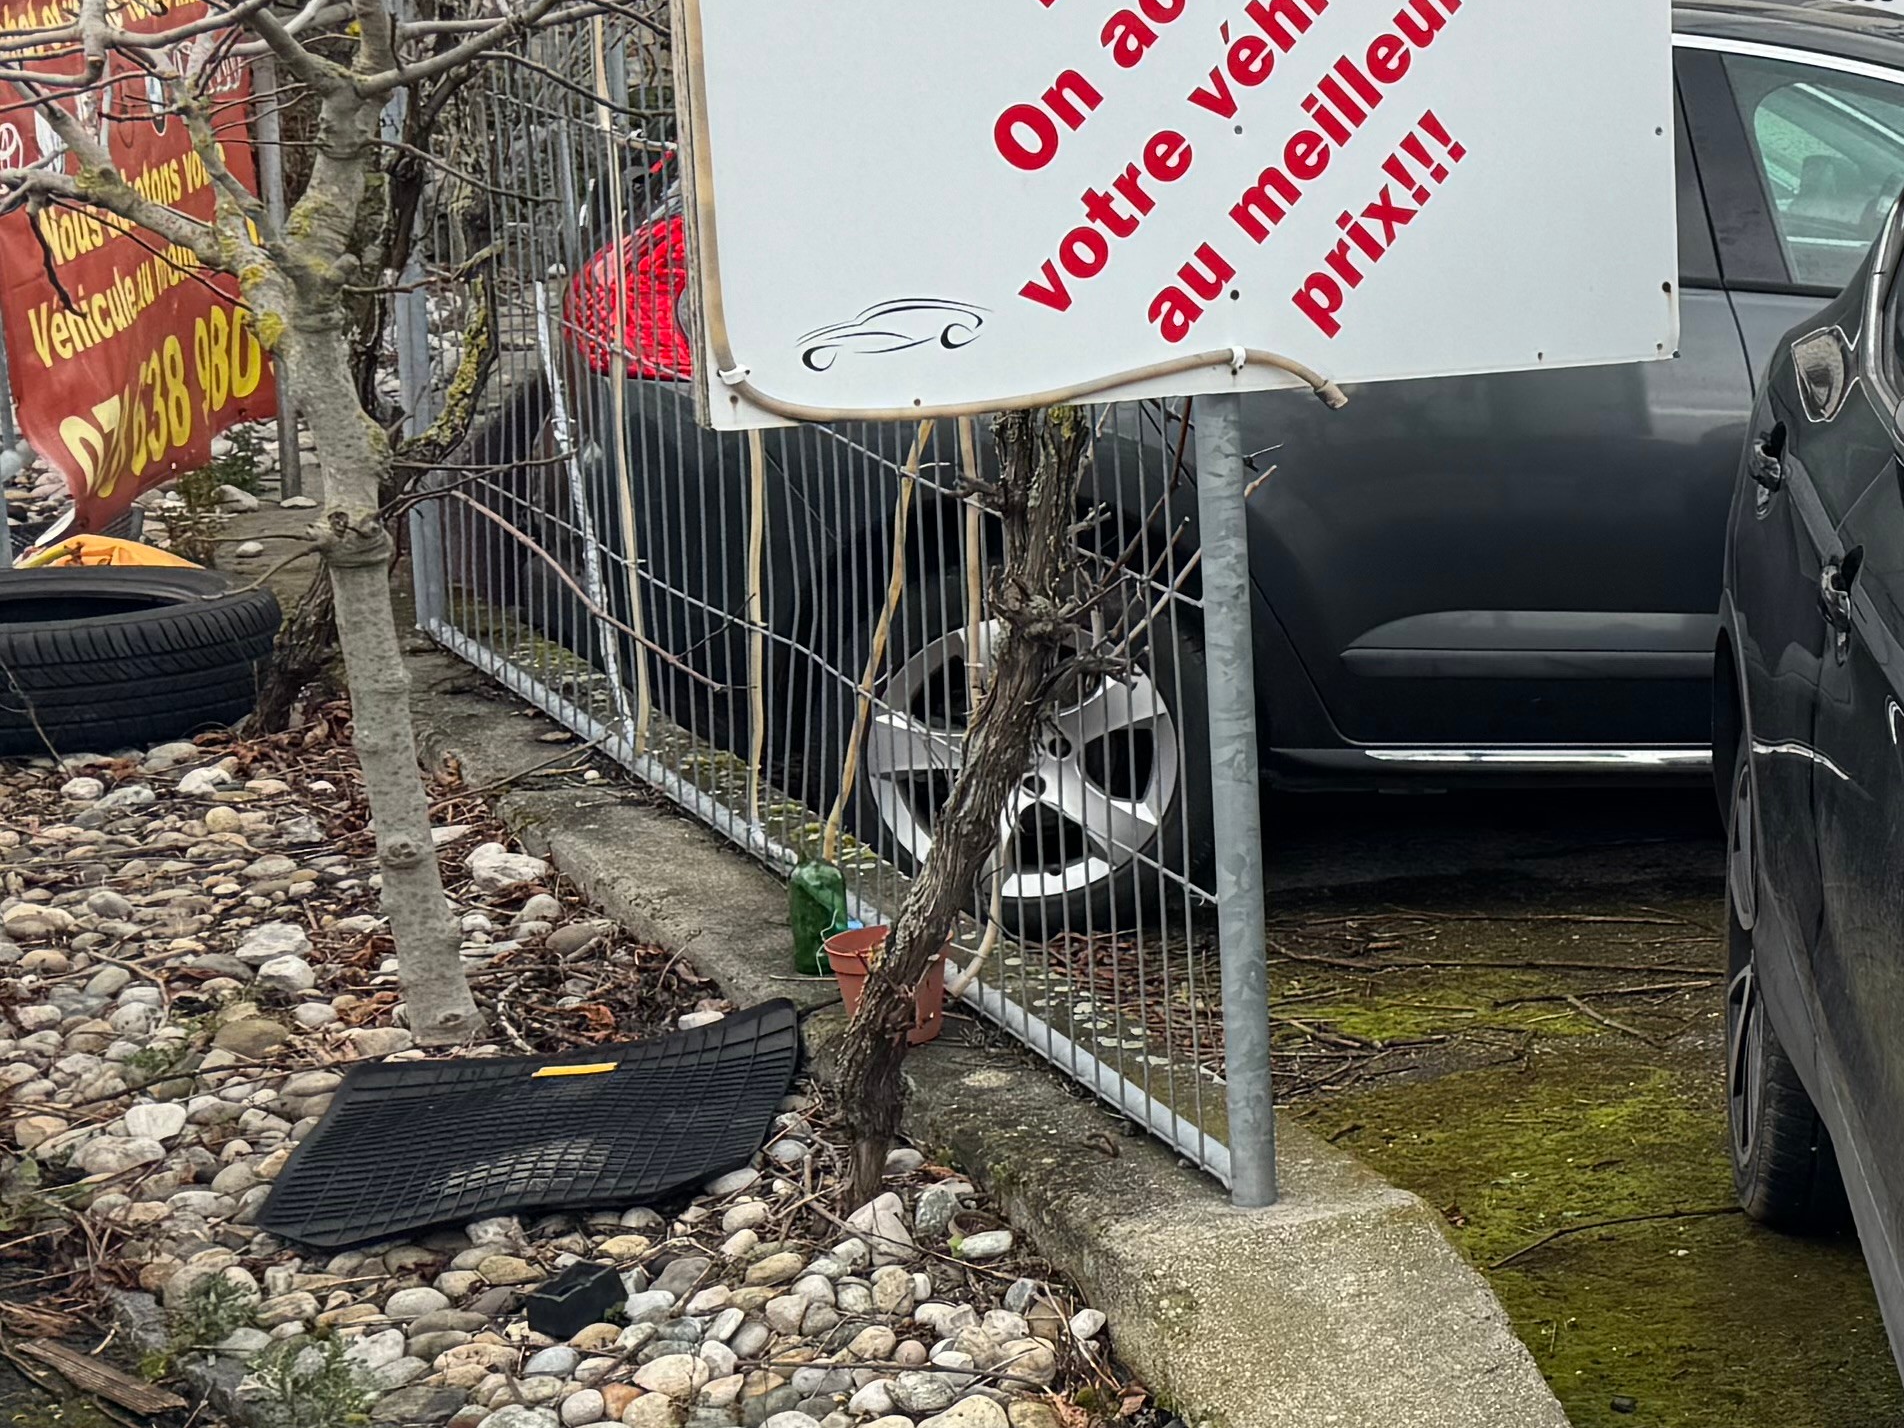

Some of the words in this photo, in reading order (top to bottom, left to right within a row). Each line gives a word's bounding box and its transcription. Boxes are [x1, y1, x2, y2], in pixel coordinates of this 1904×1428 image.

[995, 70, 1102, 170] On
[38, 203, 104, 266] Nous
[1021, 131, 1192, 311] votre
[1293, 112, 1464, 337] prix!!!
[28, 266, 137, 368] Véhicule
[1149, 244, 1234, 343] au
